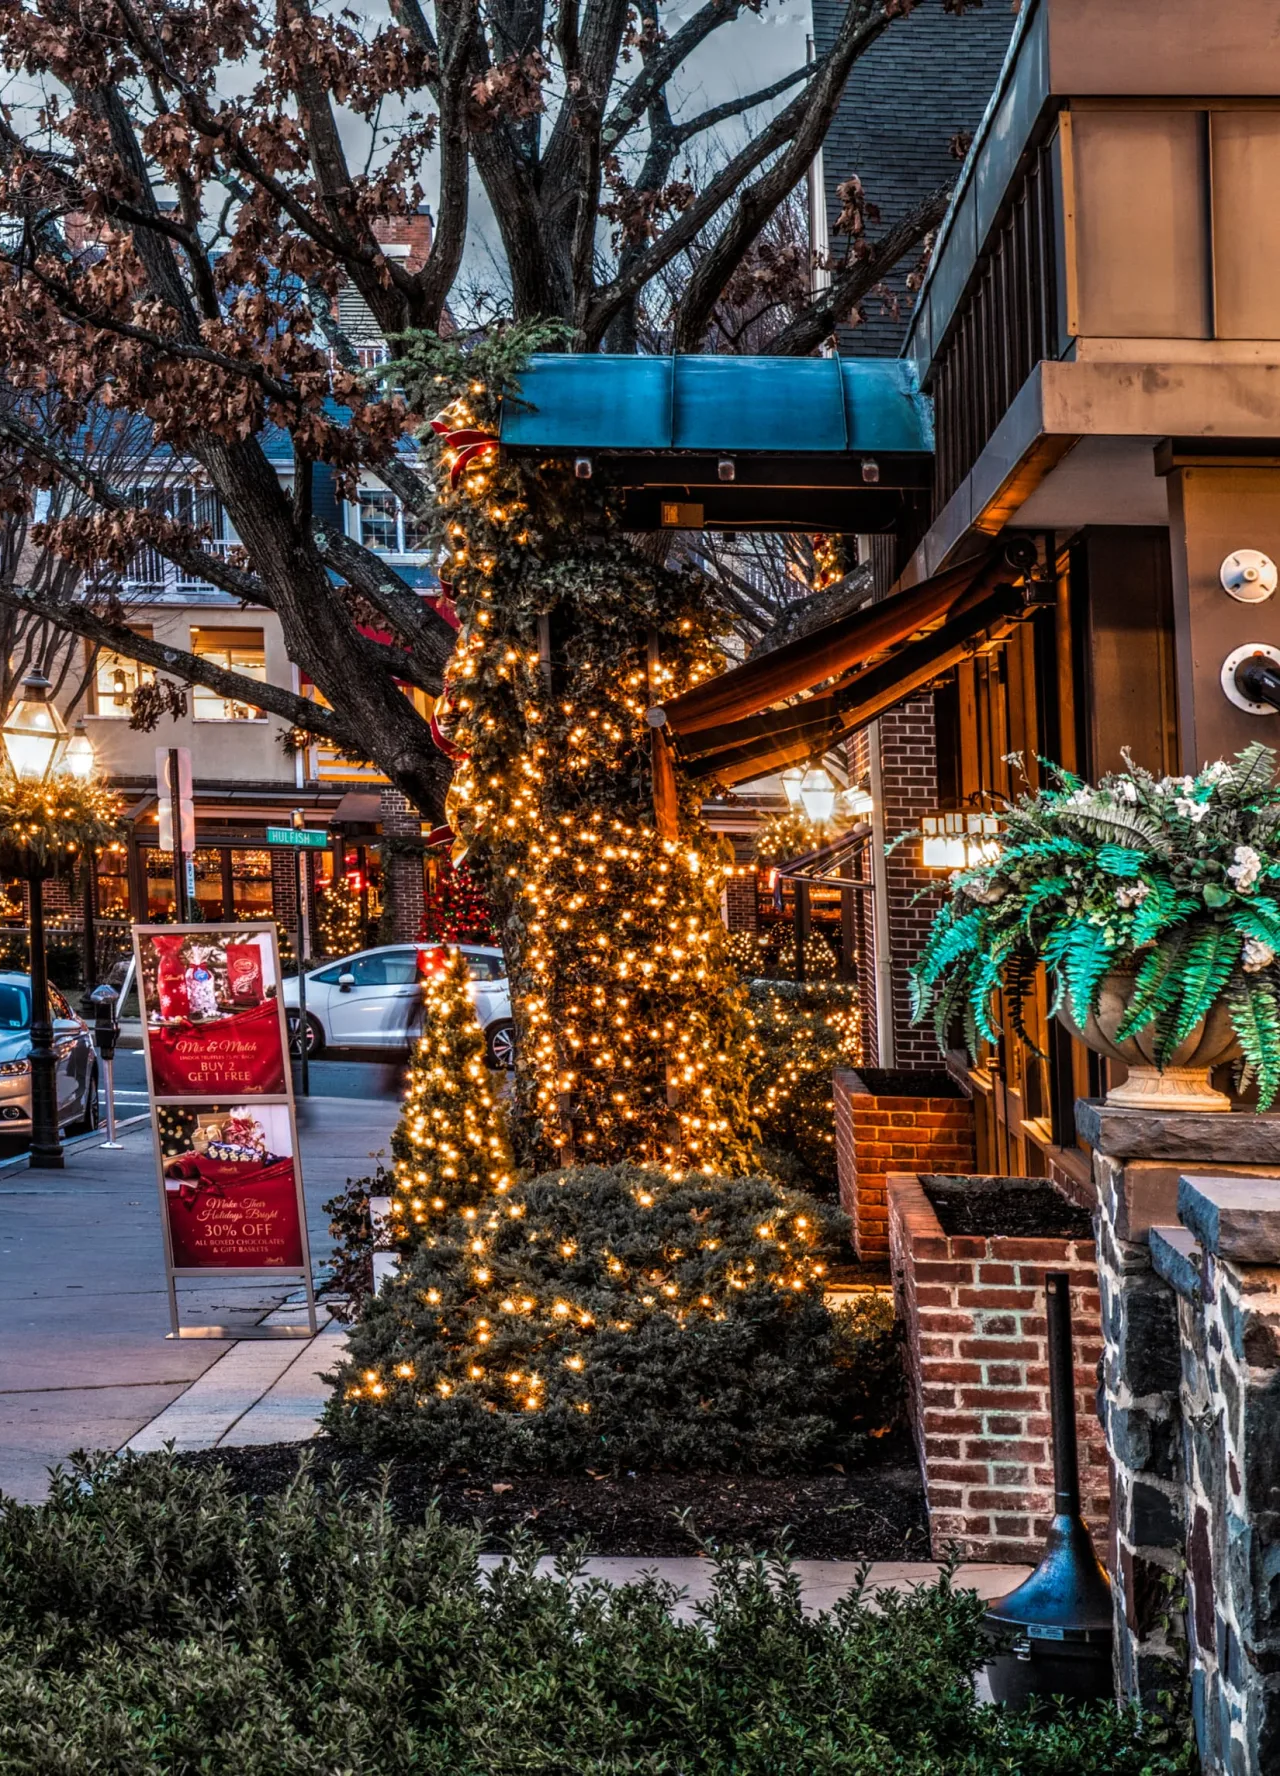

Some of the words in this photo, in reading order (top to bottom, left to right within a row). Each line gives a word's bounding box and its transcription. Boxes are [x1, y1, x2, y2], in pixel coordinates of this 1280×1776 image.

[272, 830, 310, 844] HULFISH
[175, 1040, 205, 1053] Mix
[207, 1041, 218, 1052] &
[219, 1040, 257, 1053] Match
[201, 1061, 224, 1072] BUY
[229, 1061, 235, 1071] 2
[188, 1071, 210, 1082] GET
[214, 1072, 220, 1081] 1
[224, 1071, 251, 1081] FREE
[206, 1197, 238, 1209] Make
[240, 1197, 266, 1209] Their
[196, 1209, 243, 1222] Holidays
[245, 1208, 279, 1221] Bright
[204, 1224, 237, 1236] 30%
[242, 1223, 272, 1236] OFF
